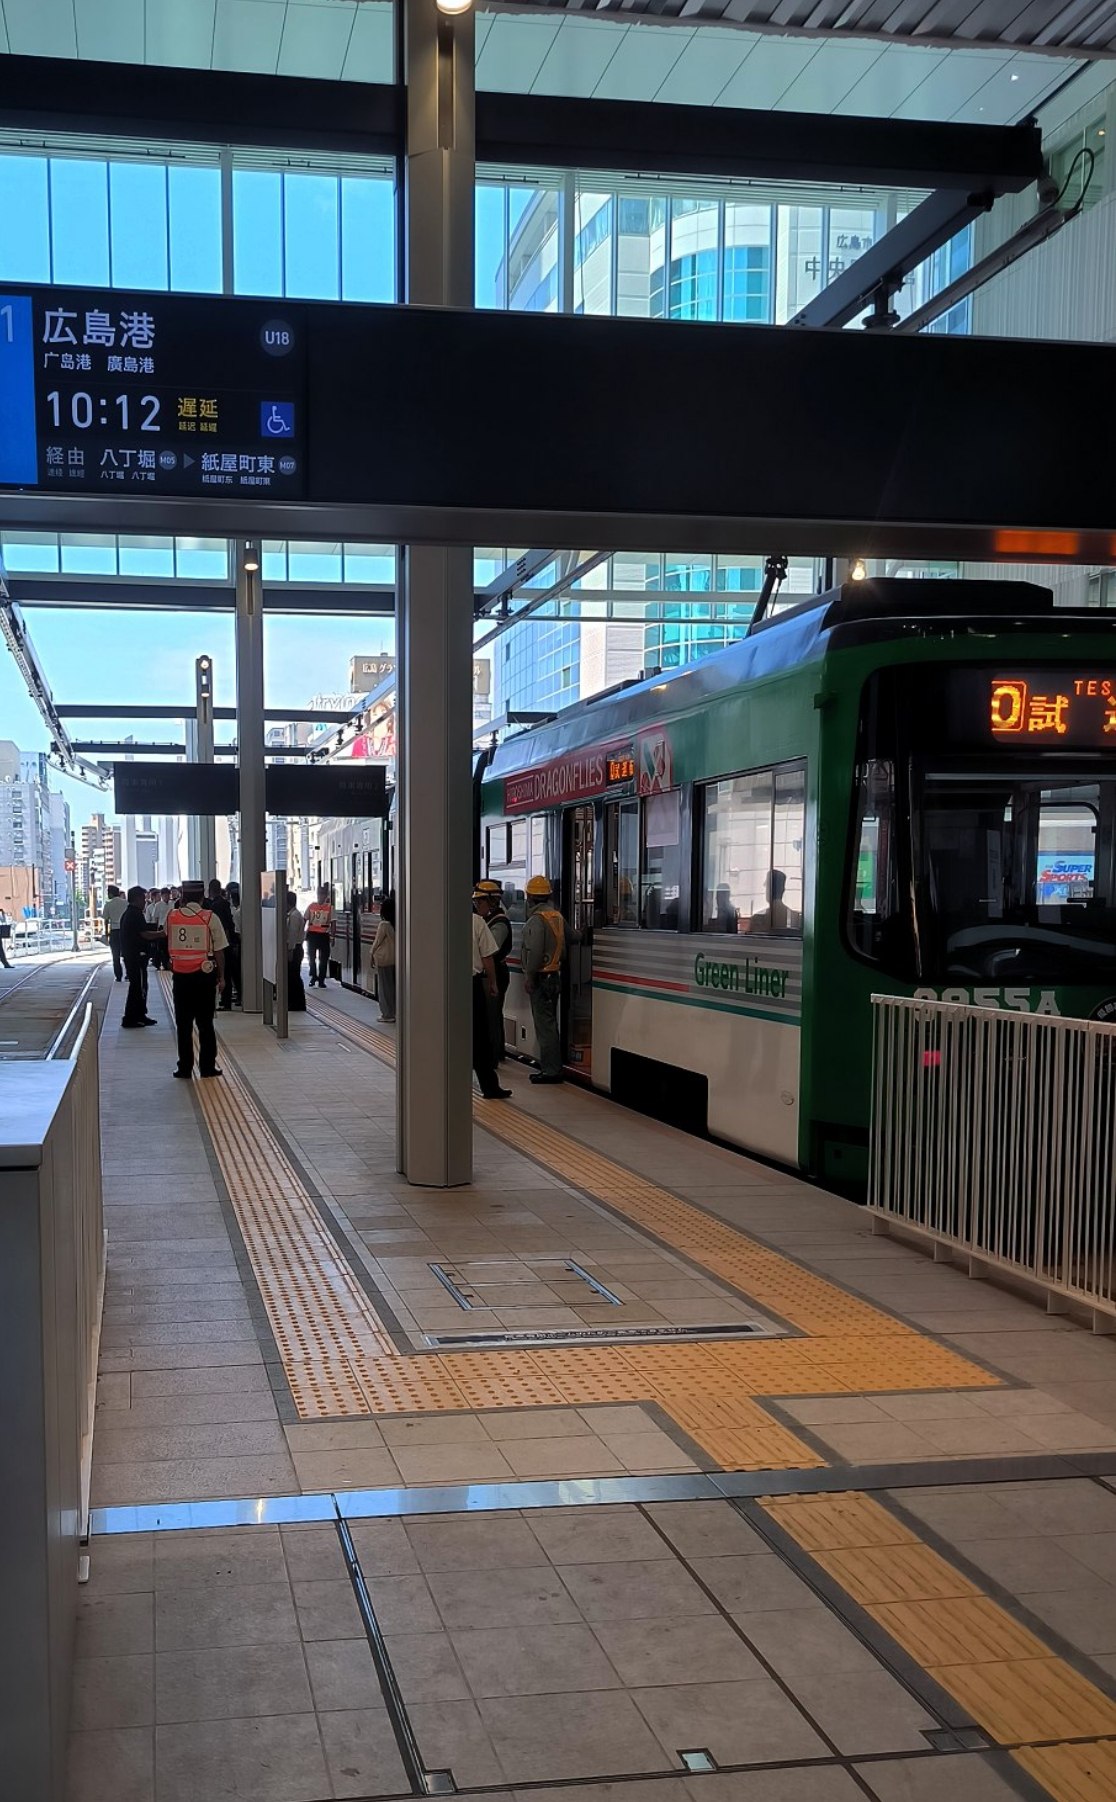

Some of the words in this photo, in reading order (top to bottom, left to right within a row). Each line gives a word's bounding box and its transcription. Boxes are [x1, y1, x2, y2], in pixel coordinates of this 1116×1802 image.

[836, 234, 873, 250] 広島市
[804, 255, 858, 281] 中央
[42, 307, 156, 349] 広島港
[264, 330, 290, 346] U18
[43, 351, 92, 371] 广岛港
[107, 355, 155, 374] 廣島港
[46, 390, 161, 432] 10:12
[45, 445, 85, 466] 経由
[100, 448, 156, 469] 八丁堀
[201, 452, 276, 474] 紙屋町東
[534, 754, 604, 801] DRAGONFLIES
[1040, 869, 1088, 883] SPORTS
[1052, 860, 1093, 873] SUPER
[178, 927, 188, 942] 8
[694, 951, 740, 992] Green
[744, 955, 790, 999] Liner
